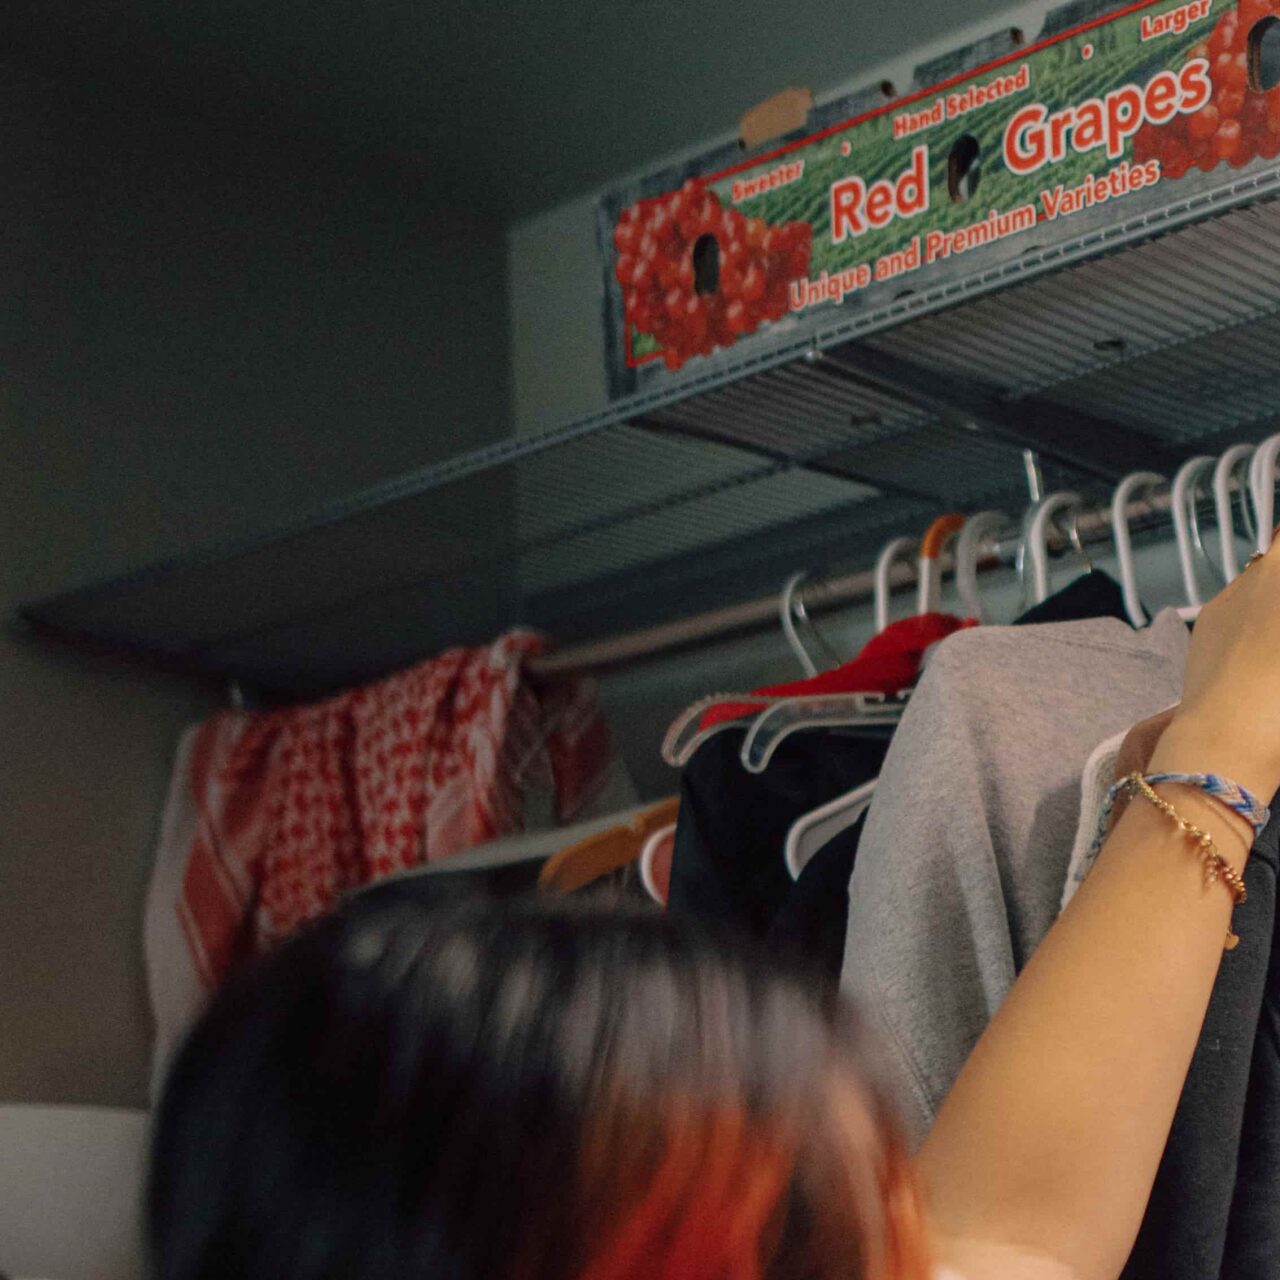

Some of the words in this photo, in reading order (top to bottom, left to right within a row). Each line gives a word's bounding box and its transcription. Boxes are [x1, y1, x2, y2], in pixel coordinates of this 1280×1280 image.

[1141, 0, 1212, 41] Larger
[893, 98, 945, 140] Hand
[946, 63, 1030, 119] Selected
[731, 159, 805, 203] Sweeter
[830, 144, 930, 244] Red
[1003, 57, 1212, 175] Grapes
[790, 263, 872, 311] Unique
[874, 235, 921, 282] and
[926, 203, 1037, 263] Premium
[1041, 159, 1160, 220] Varieties
